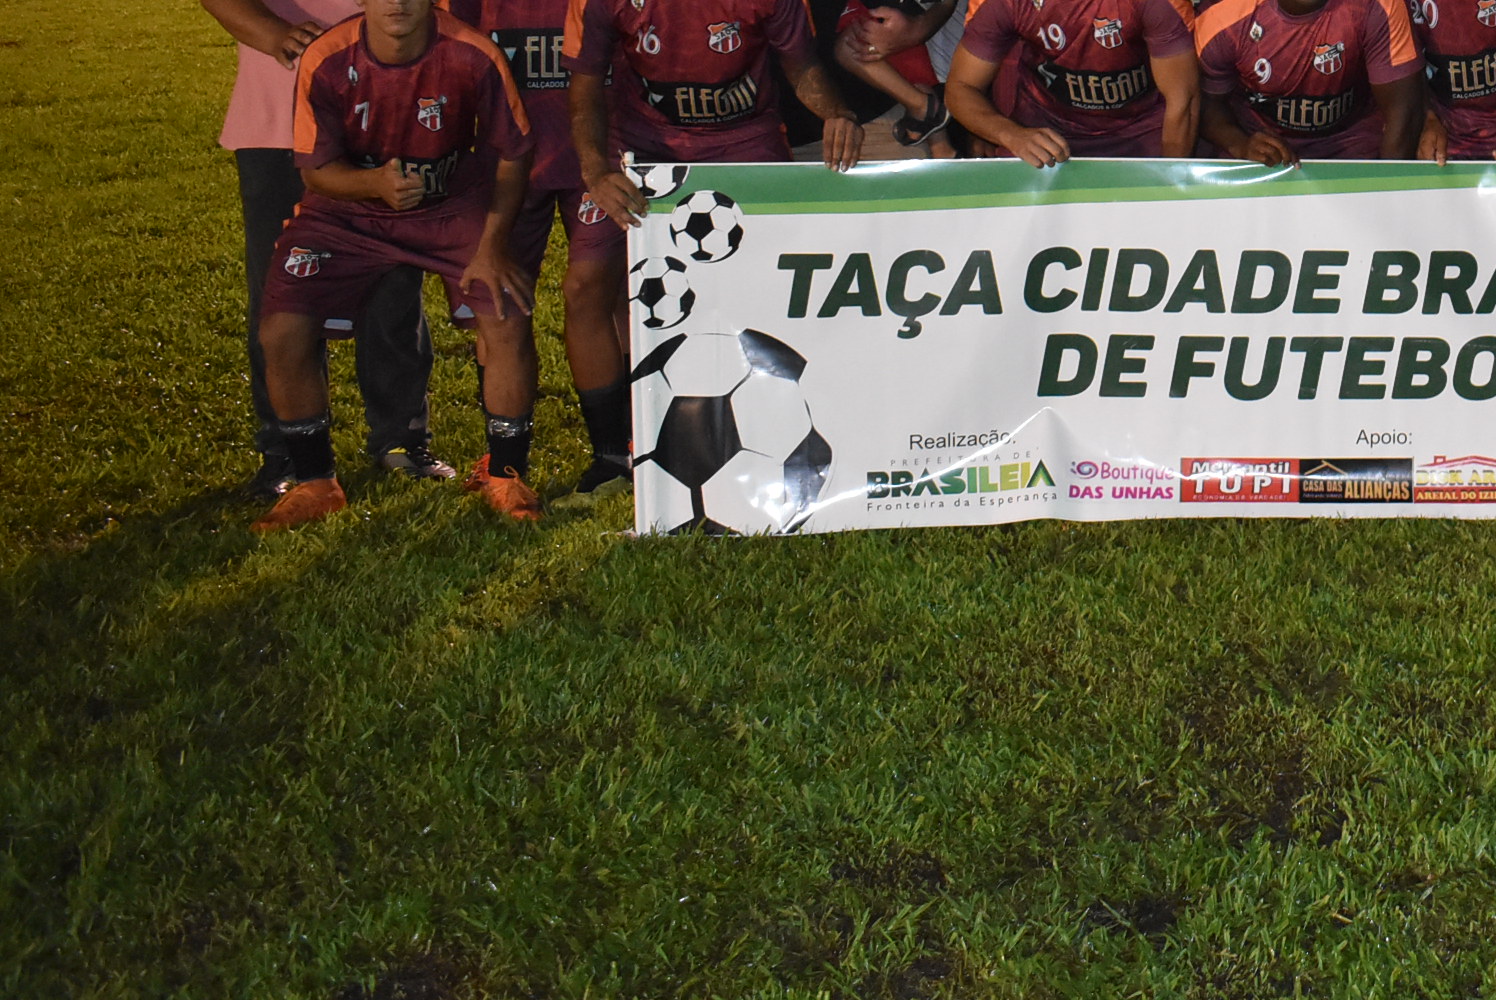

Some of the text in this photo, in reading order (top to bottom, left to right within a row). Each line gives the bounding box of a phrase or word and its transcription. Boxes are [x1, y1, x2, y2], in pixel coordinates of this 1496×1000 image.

[634, 24, 661, 55] 16
[1037, 23, 1067, 51] 19
[1253, 57, 1273, 84] 9
[354, 101, 370, 132] 7
[777, 248, 1004, 340] TAÇA
[1023, 246, 1350, 315] CIDADE
[1036, 333, 1156, 399] DE
[1355, 428, 1413, 449] Apoio:
[1013, 450, 1031, 460] DE
[866, 491, 1058, 513] Fronteira da Esperança
[1069, 484, 1174, 499] DAS UNHAS
[1303, 480, 1325, 493] CASA
[1326, 480, 1343, 493] DAS
[1344, 480, 1411, 503] ALIANÇAS
[1416, 490, 1459, 500] AREIAL
[1460, 490, 1477, 500] DO
